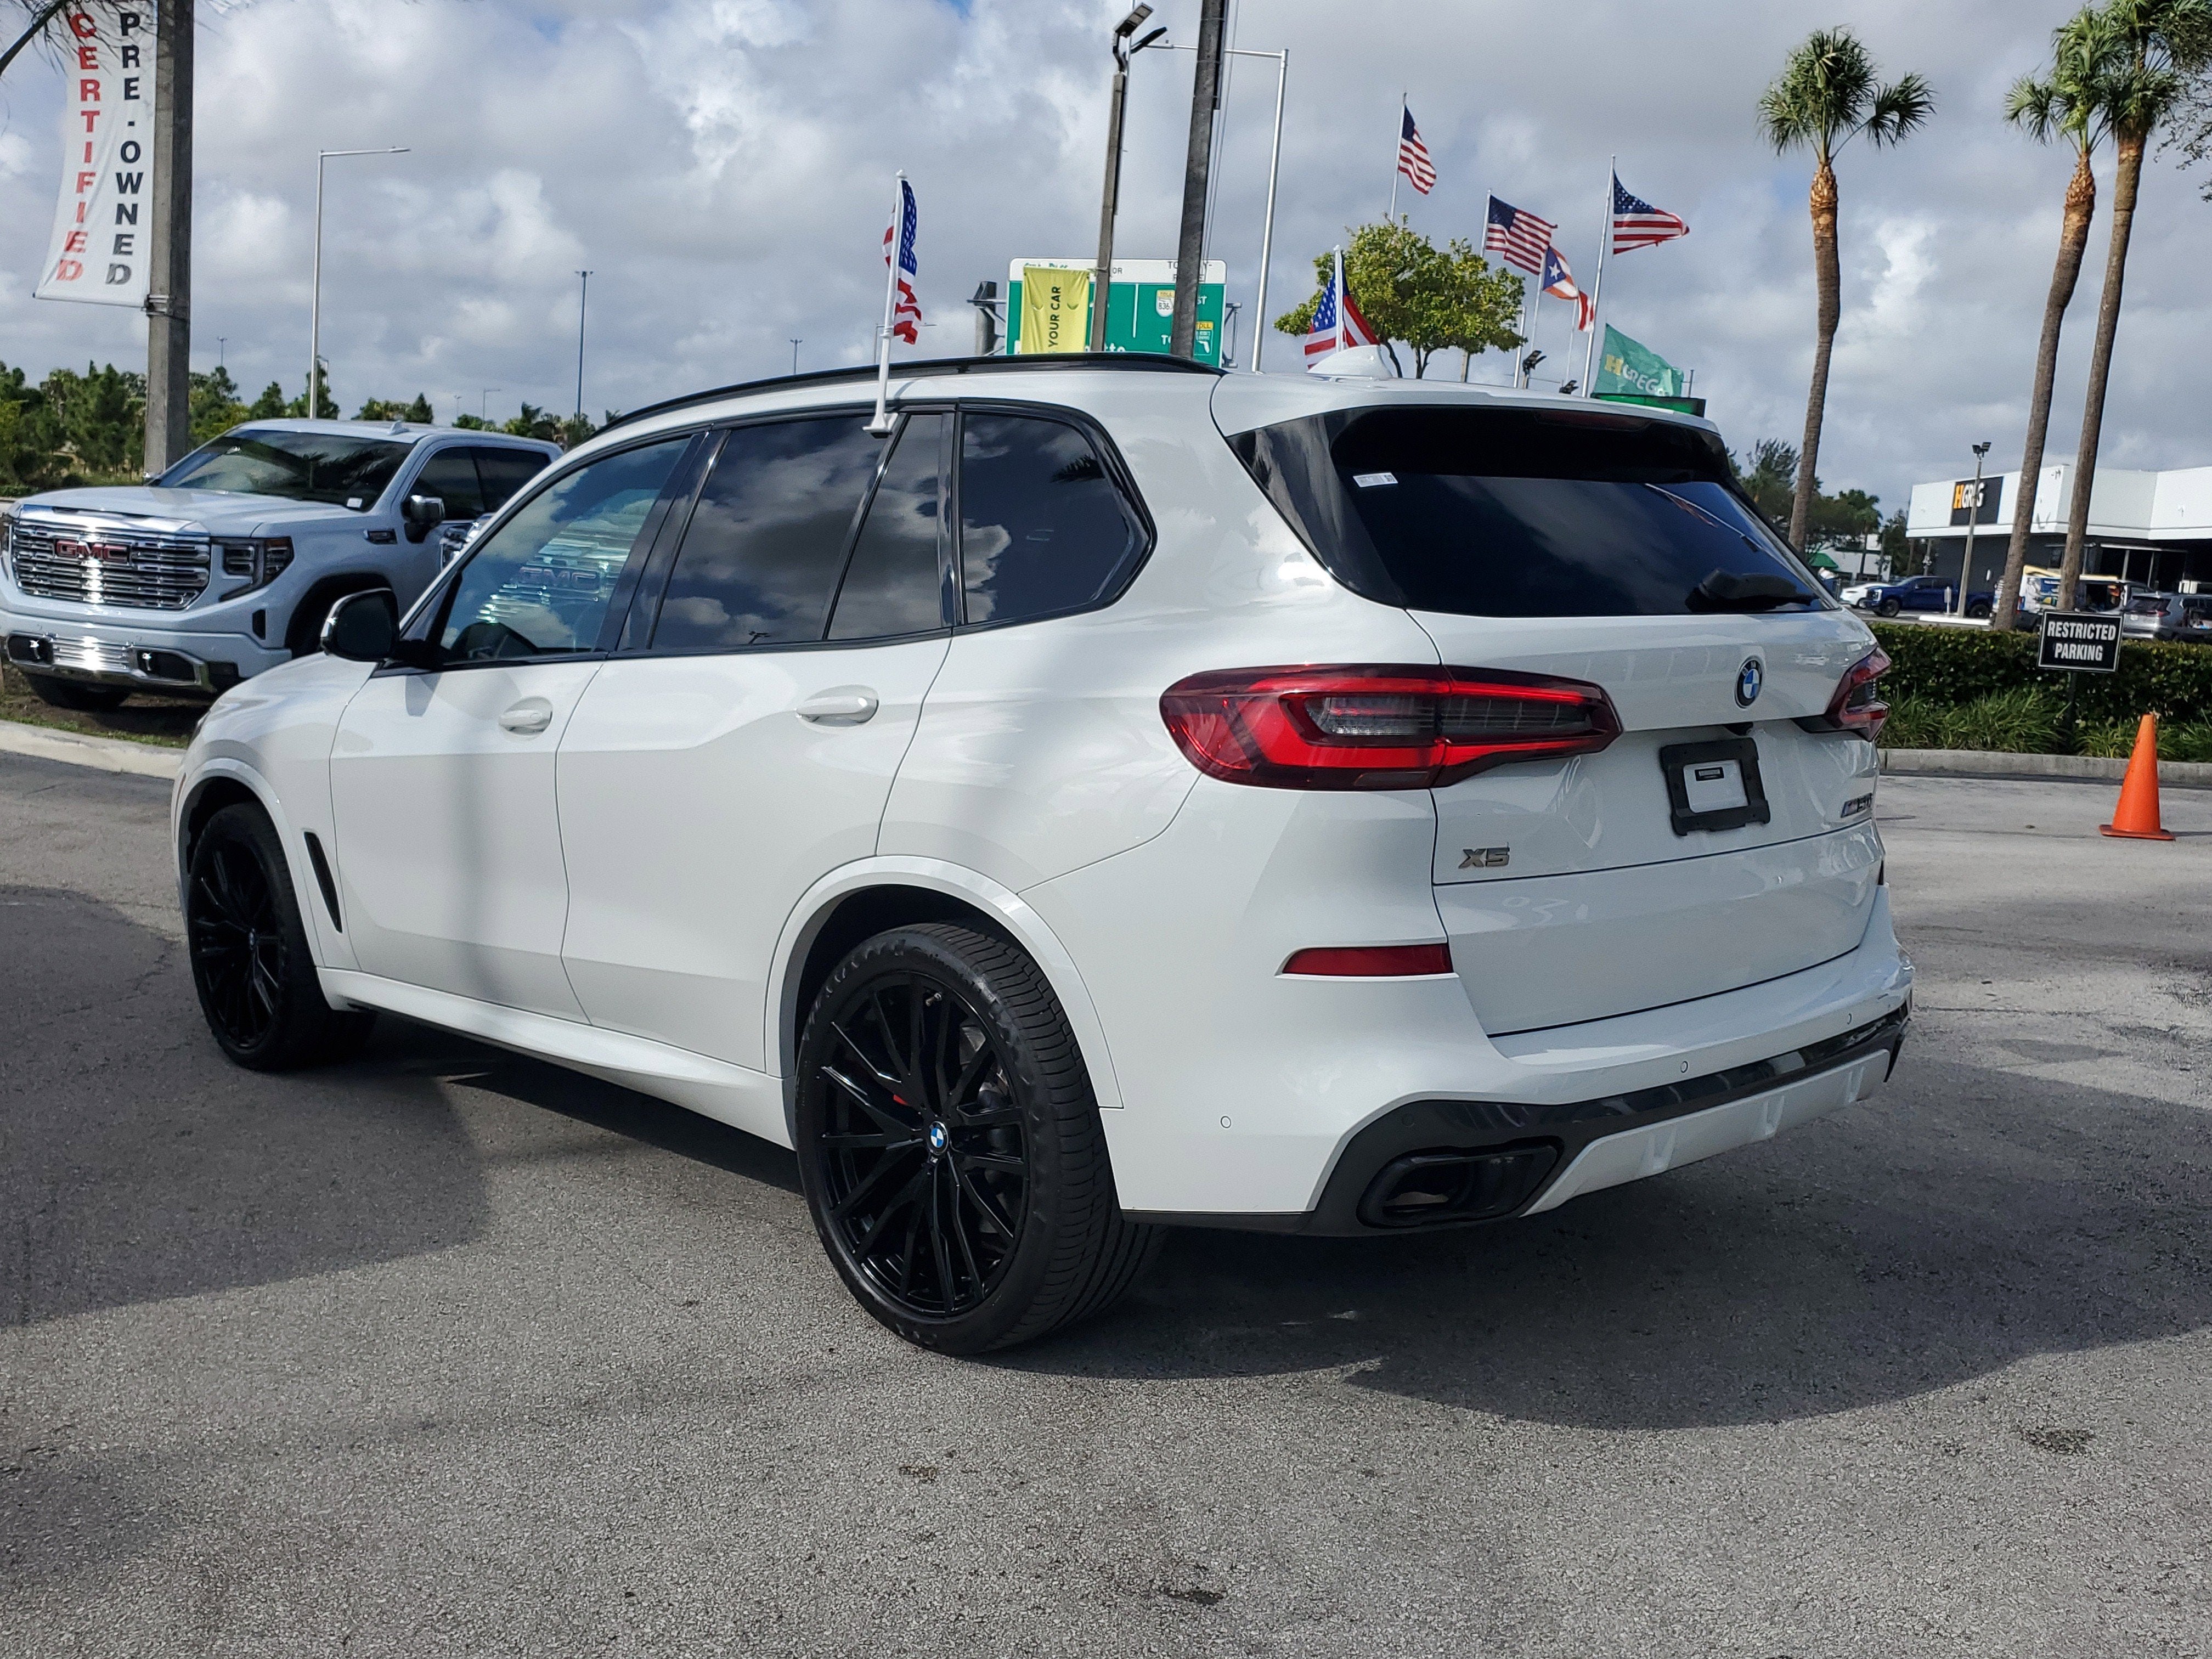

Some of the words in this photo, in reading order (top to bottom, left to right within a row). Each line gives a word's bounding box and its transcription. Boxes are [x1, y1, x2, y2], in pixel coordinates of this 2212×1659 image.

[56, 13, 100, 281] CERTIFIED
[105, 13, 144, 285] PRE-OWNED
[1050, 286, 1062, 311] CAR
[1048, 314, 1060, 348] YOUR
[1954, 482, 1985, 509] HGRG
[57, 540, 128, 564] GMC
[2047, 621, 2117, 641] RESTRICTED
[2054, 642, 2103, 661] PARKING
[1458, 847, 1510, 869] X5
